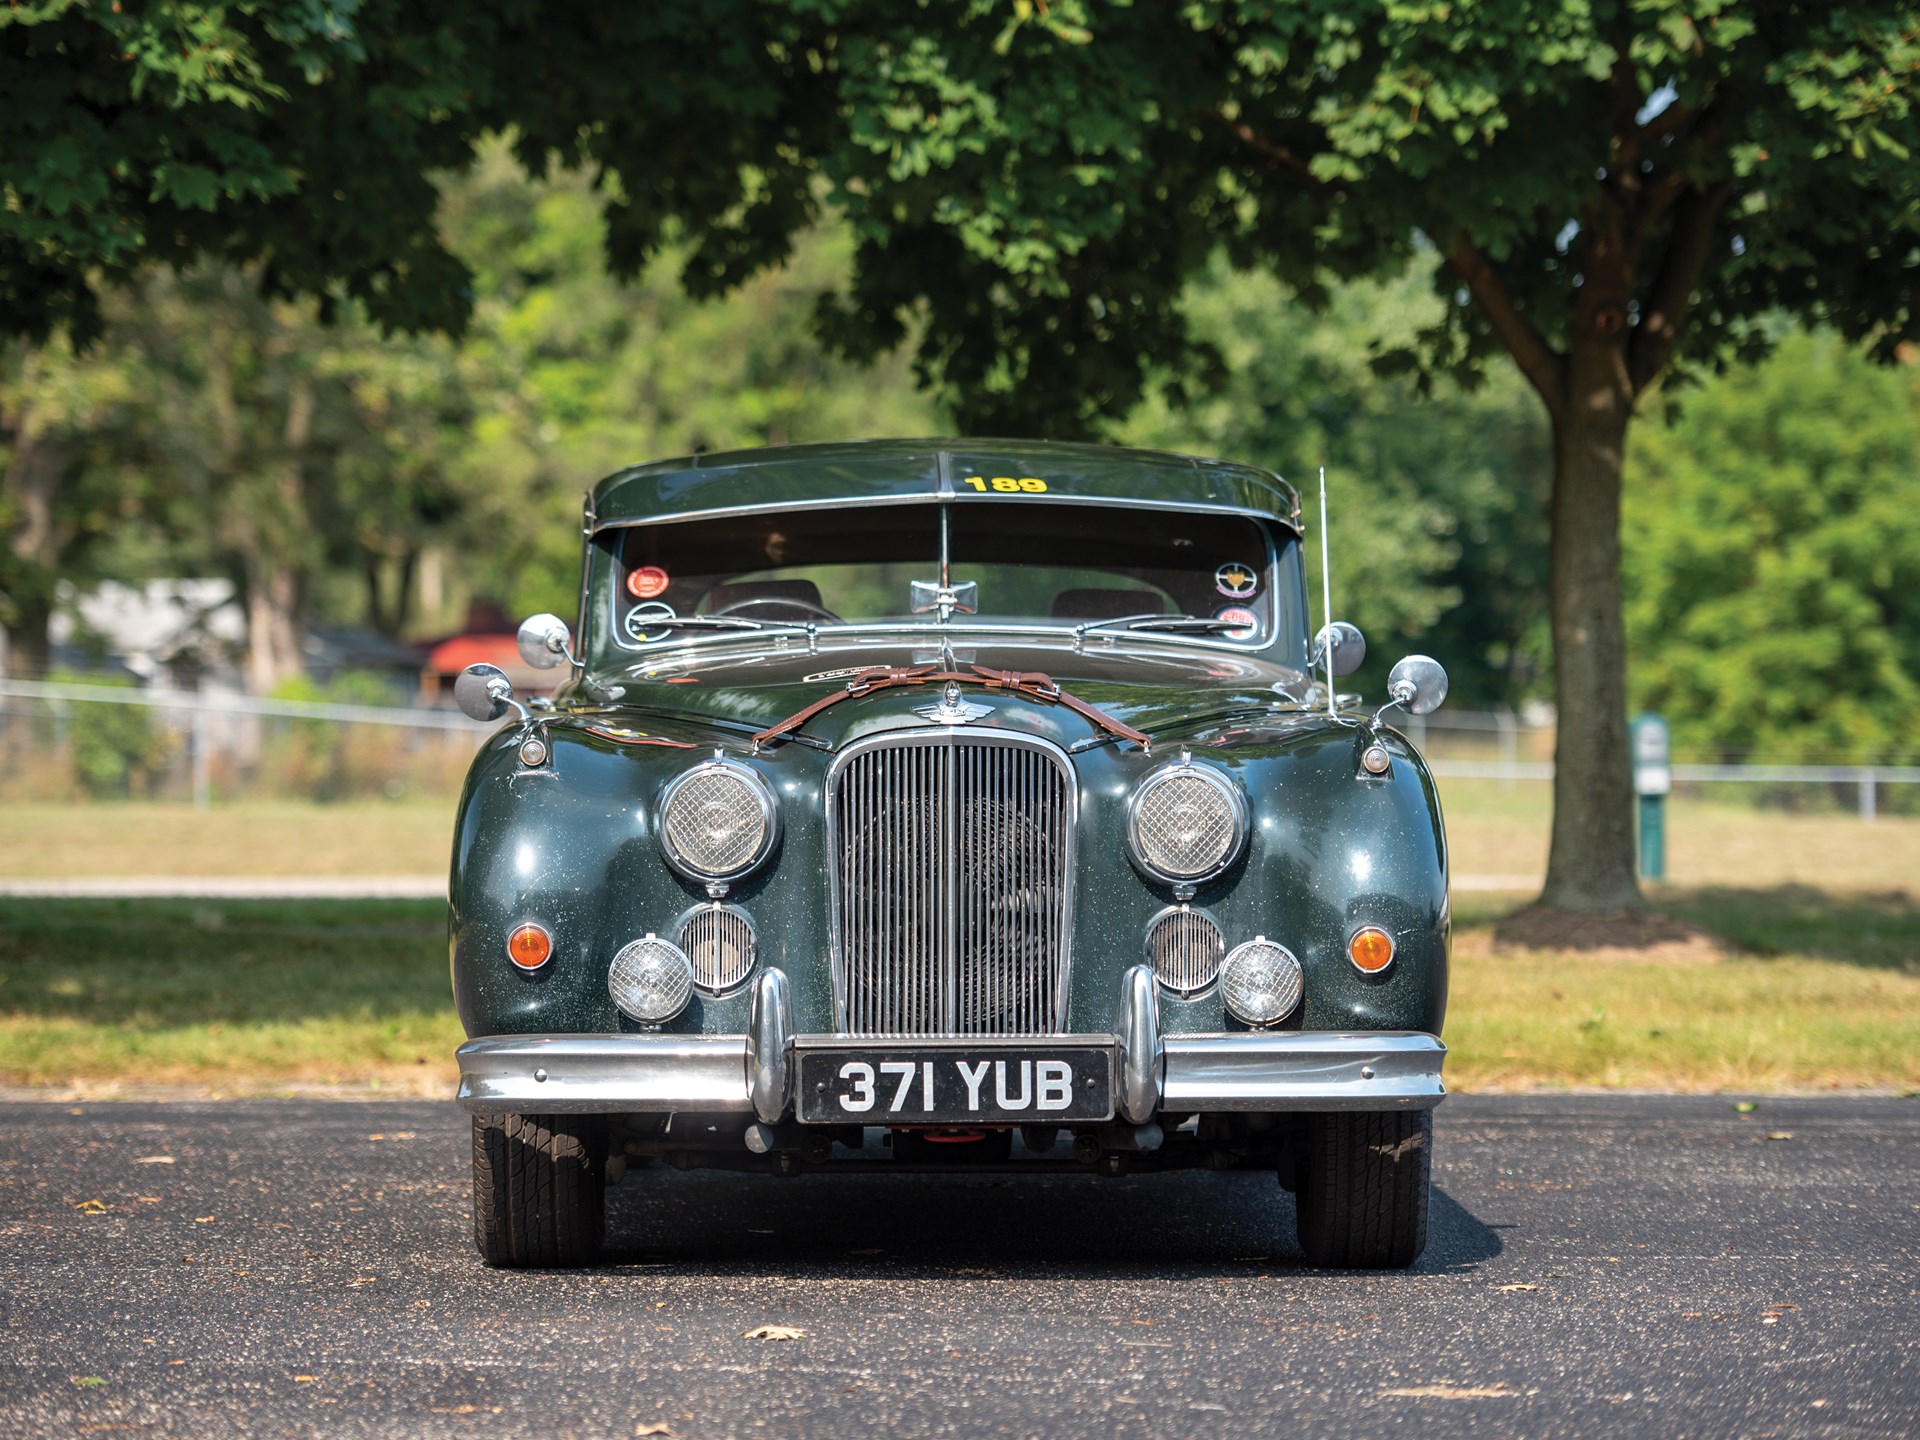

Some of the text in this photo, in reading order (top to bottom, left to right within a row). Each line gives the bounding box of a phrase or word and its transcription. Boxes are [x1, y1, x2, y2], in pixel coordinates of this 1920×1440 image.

[964, 476, 1048, 493] 189
[839, 1060, 1073, 1112] 371 YUB
